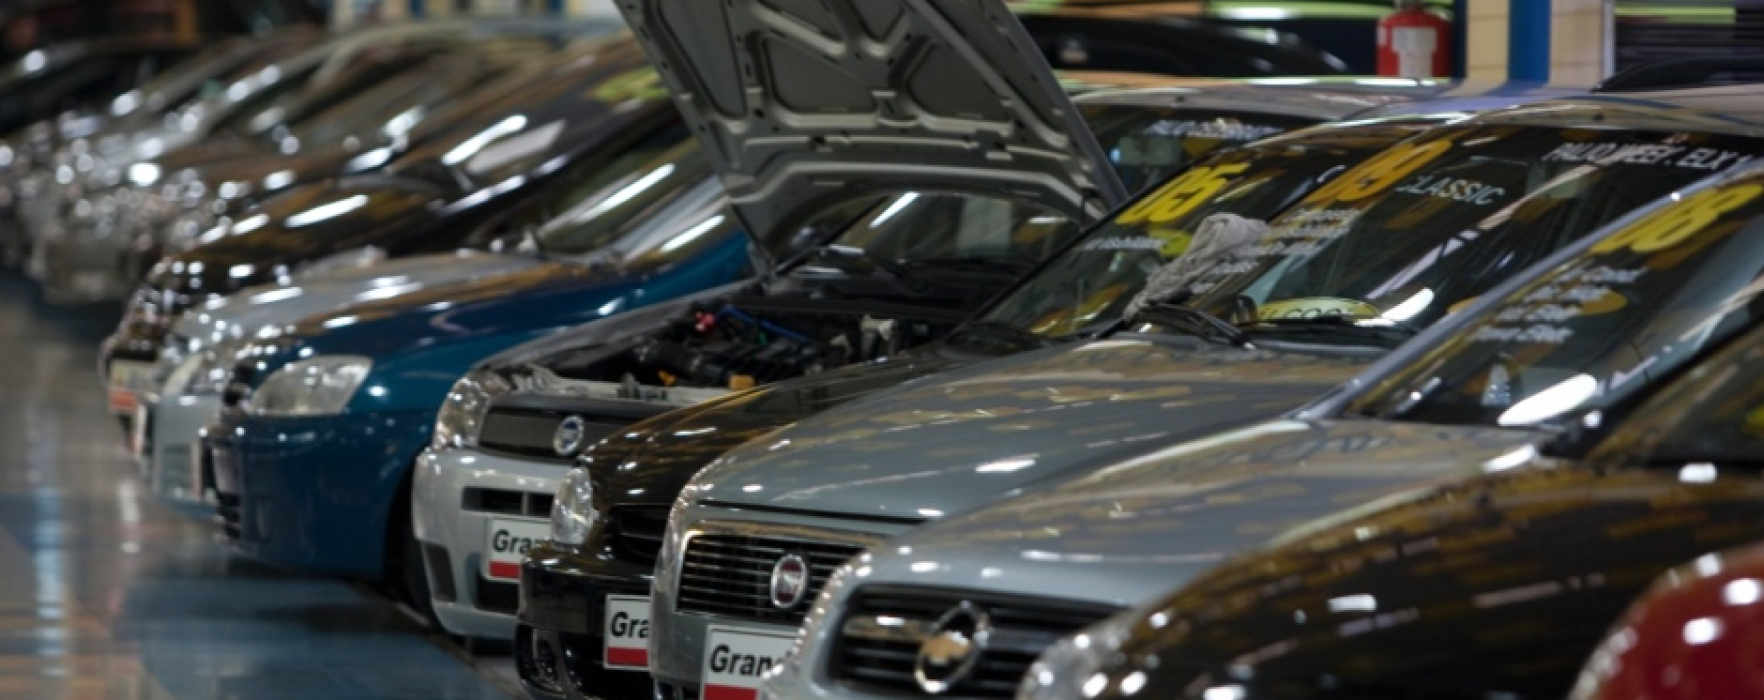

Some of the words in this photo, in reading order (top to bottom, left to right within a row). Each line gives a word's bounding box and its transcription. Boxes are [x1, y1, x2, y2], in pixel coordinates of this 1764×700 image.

[1676, 147, 1739, 169] ELX
[1114, 162, 1250, 224] 05
[1588, 184, 1764, 254] 08
[710, 643, 792, 677] Gran
